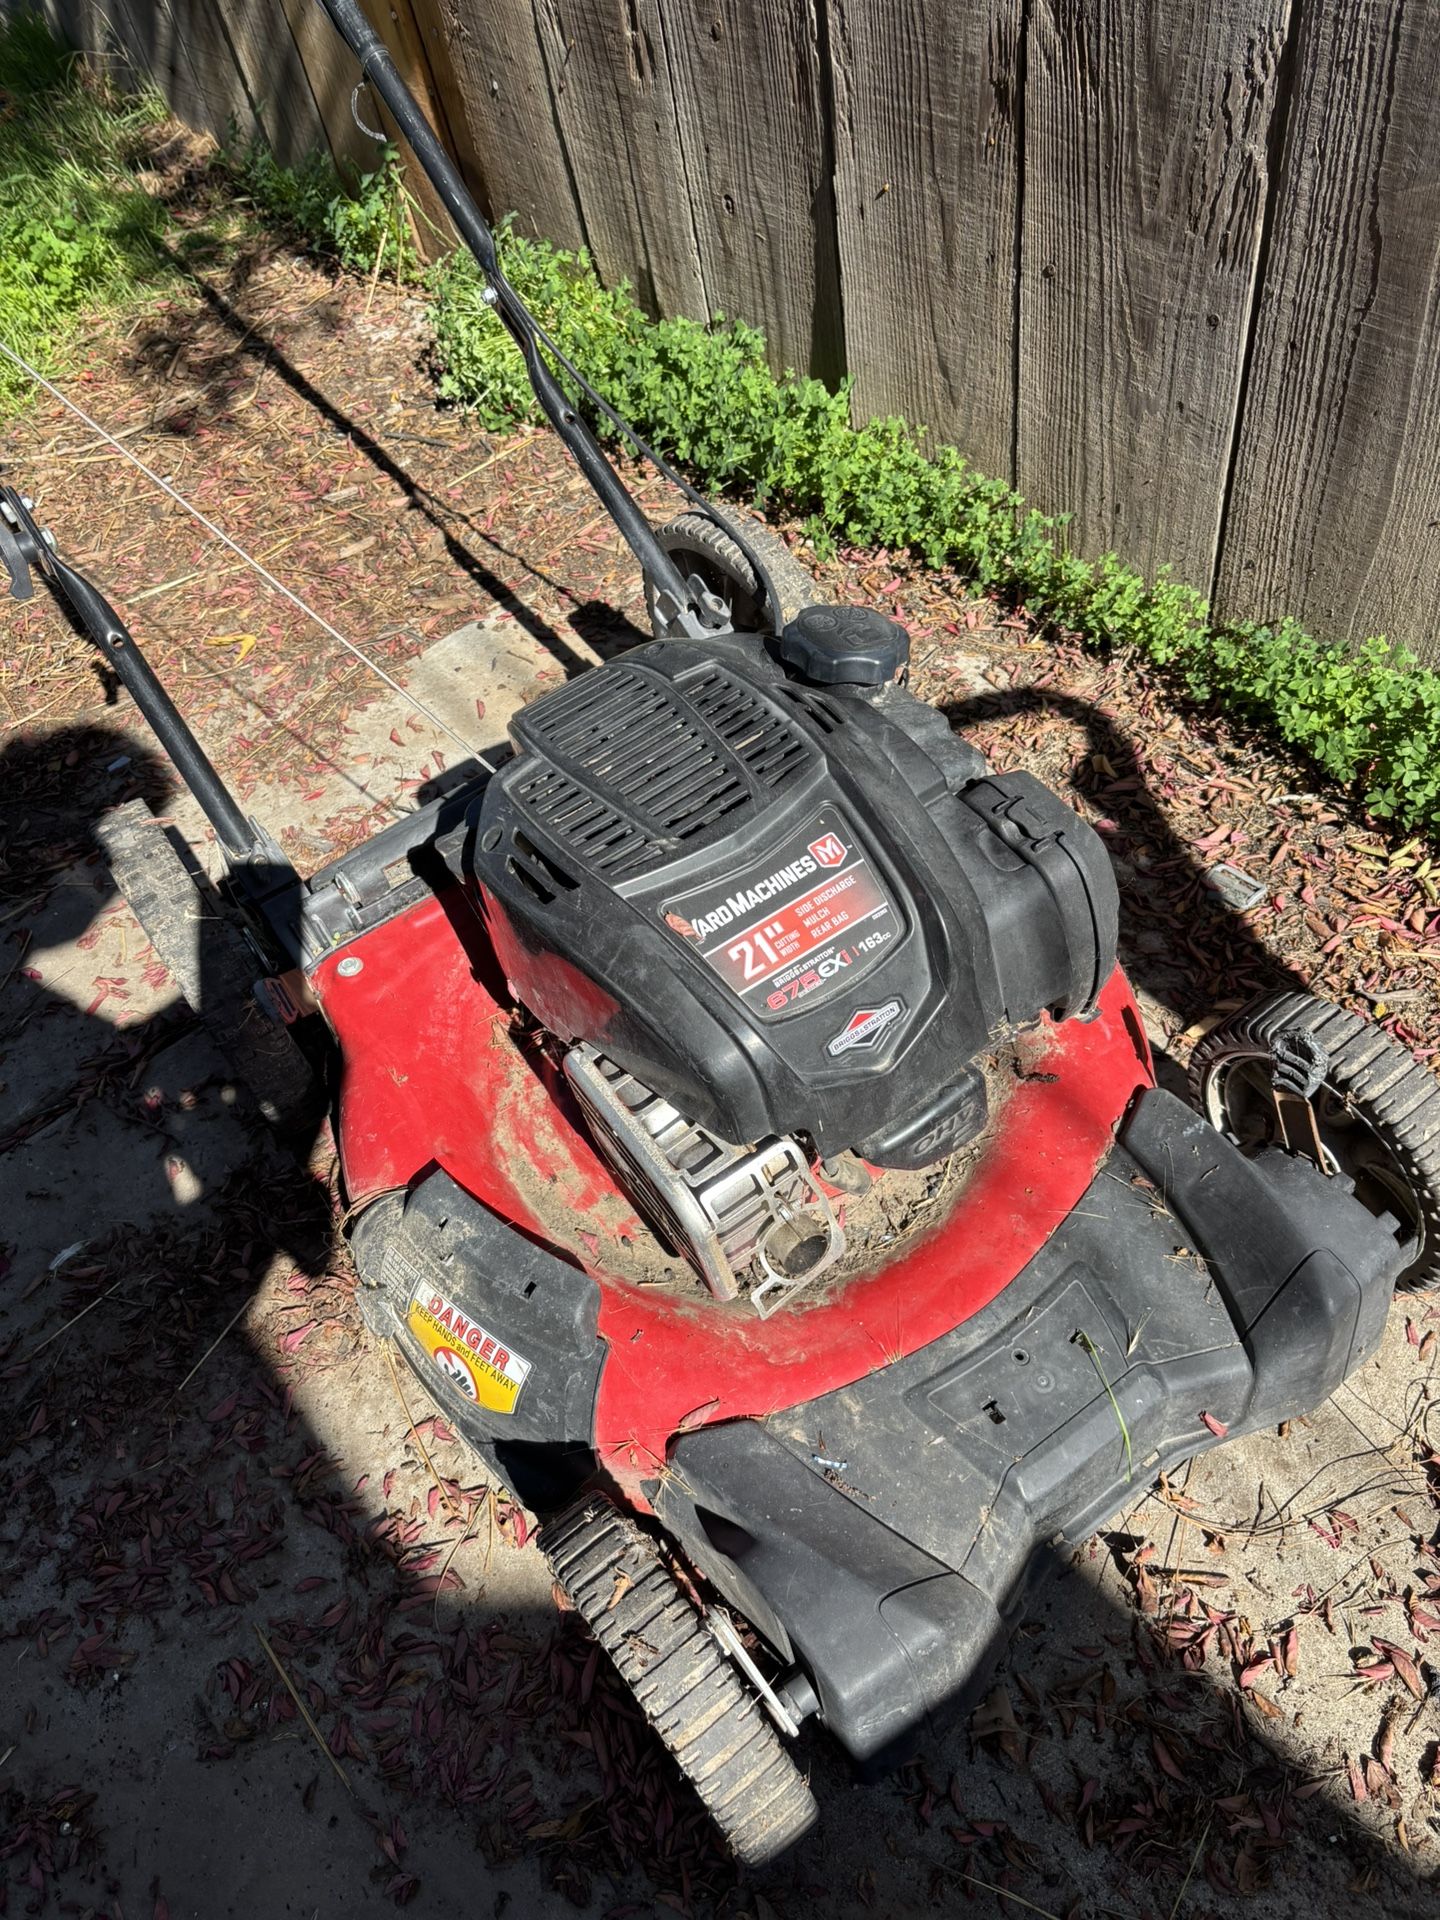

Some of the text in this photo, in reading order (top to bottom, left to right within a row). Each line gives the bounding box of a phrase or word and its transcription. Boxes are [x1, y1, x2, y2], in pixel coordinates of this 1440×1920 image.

[725, 855, 817, 917] MACHINES
[794, 874, 857, 917] SIDE DISCHARGE
[802, 907, 831, 928] MULCH
[810, 911, 849, 939] REAR BAG
[727, 921, 785, 981] 21"
[774, 929, 801, 950] CUTTING
[780, 940, 801, 957] WIDTH
[415, 1304, 516, 1391] KEEP HANDS and FEET AWAY
[428, 1295, 510, 1372] DANGER
